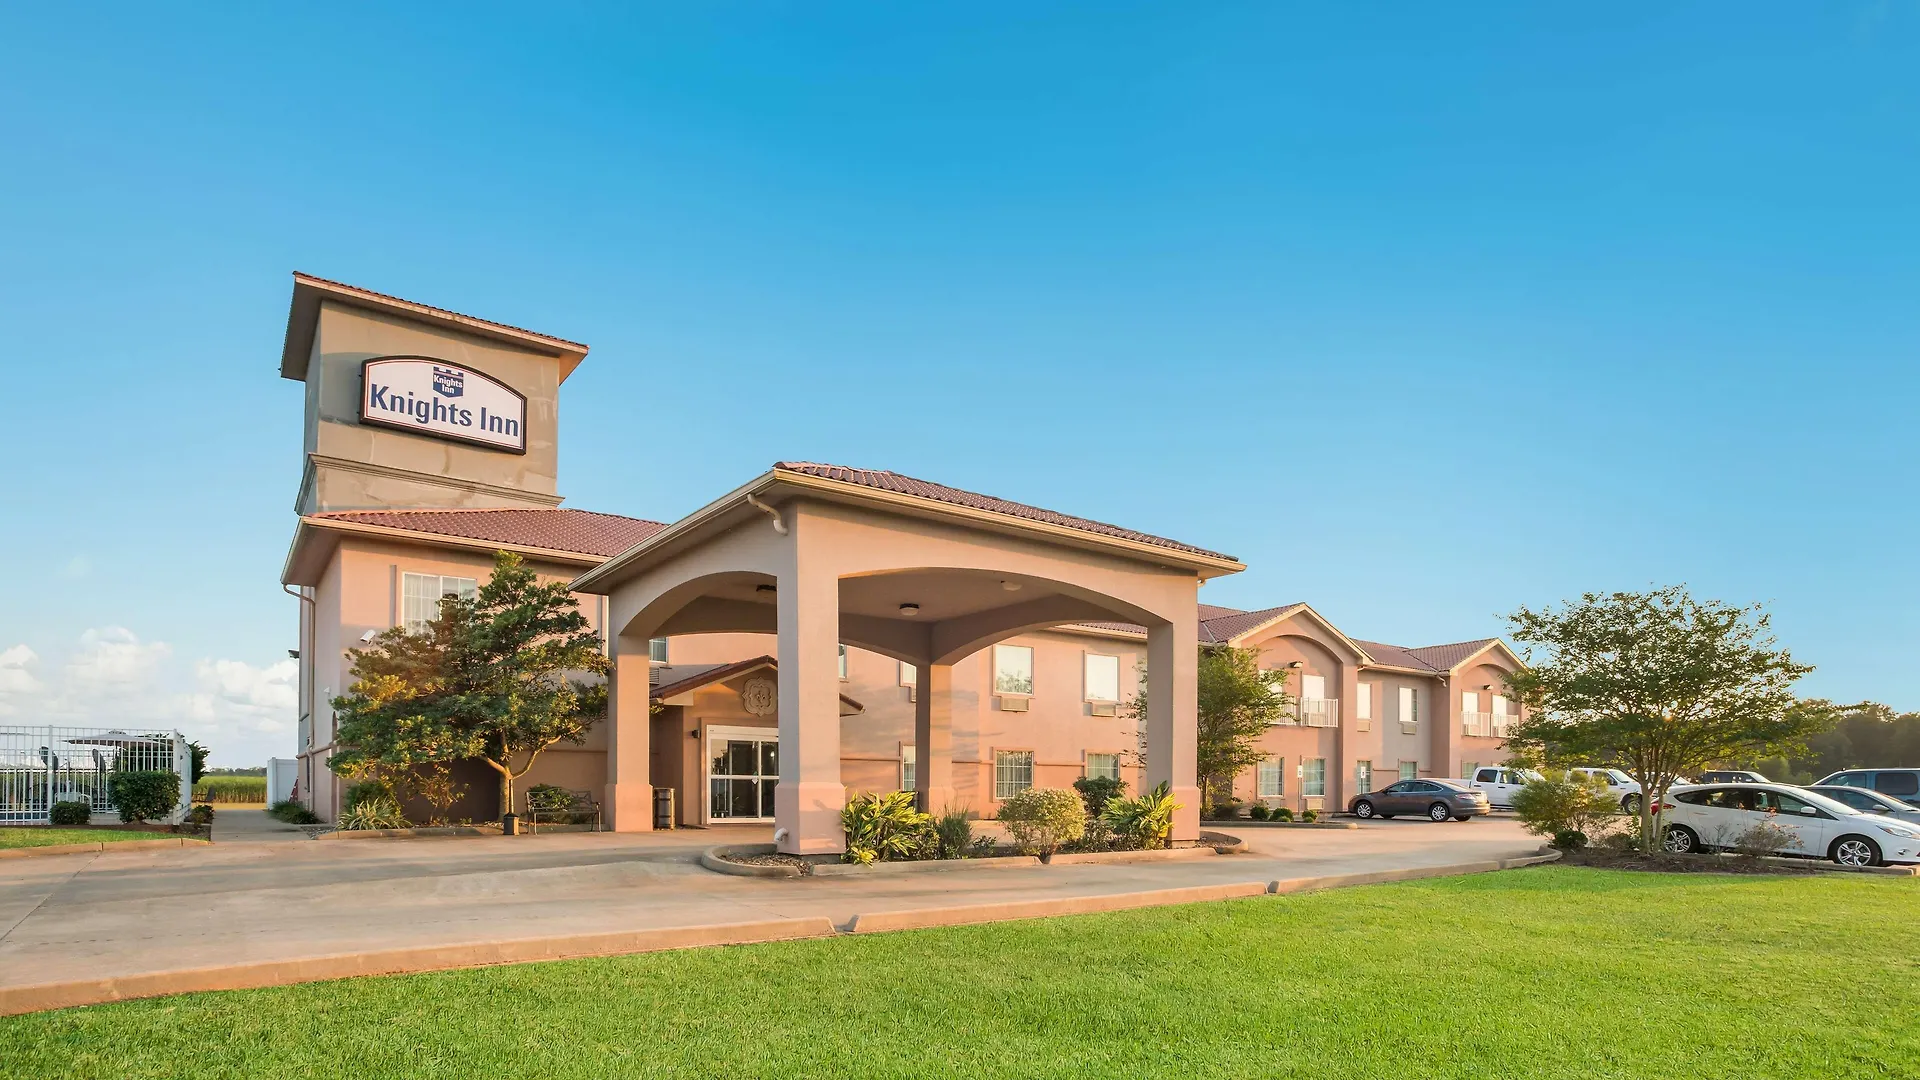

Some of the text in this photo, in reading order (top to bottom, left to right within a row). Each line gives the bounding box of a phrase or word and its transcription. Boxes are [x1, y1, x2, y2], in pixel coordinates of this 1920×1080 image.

[433, 375, 463, 388] Knights
[441, 384, 455, 394] Inn
[371, 383, 518, 436] Knights Inn
